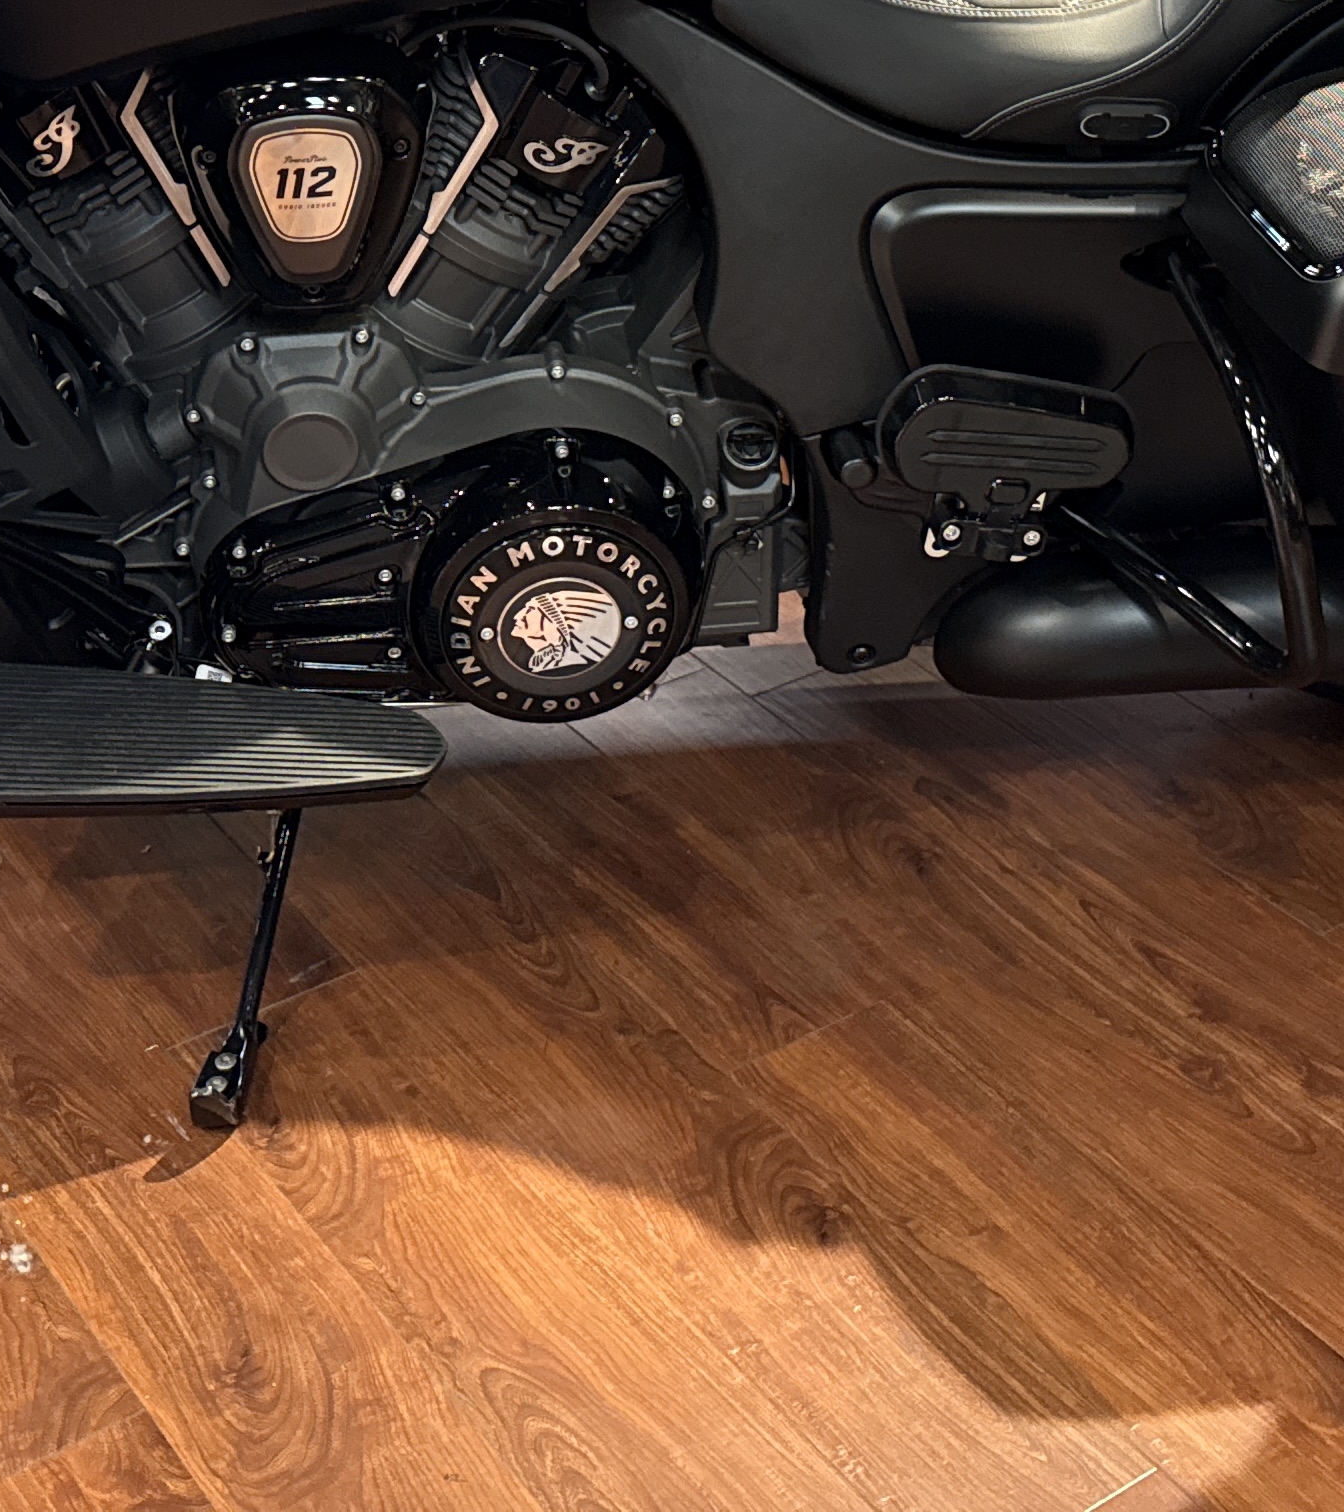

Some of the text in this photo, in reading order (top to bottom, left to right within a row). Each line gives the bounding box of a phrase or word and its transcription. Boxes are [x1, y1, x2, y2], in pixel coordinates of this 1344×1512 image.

[275, 165, 338, 199] 112
[450, 534, 667, 688] INDIAN MOTORCYCLE
[521, 691, 602, 713] 1901
